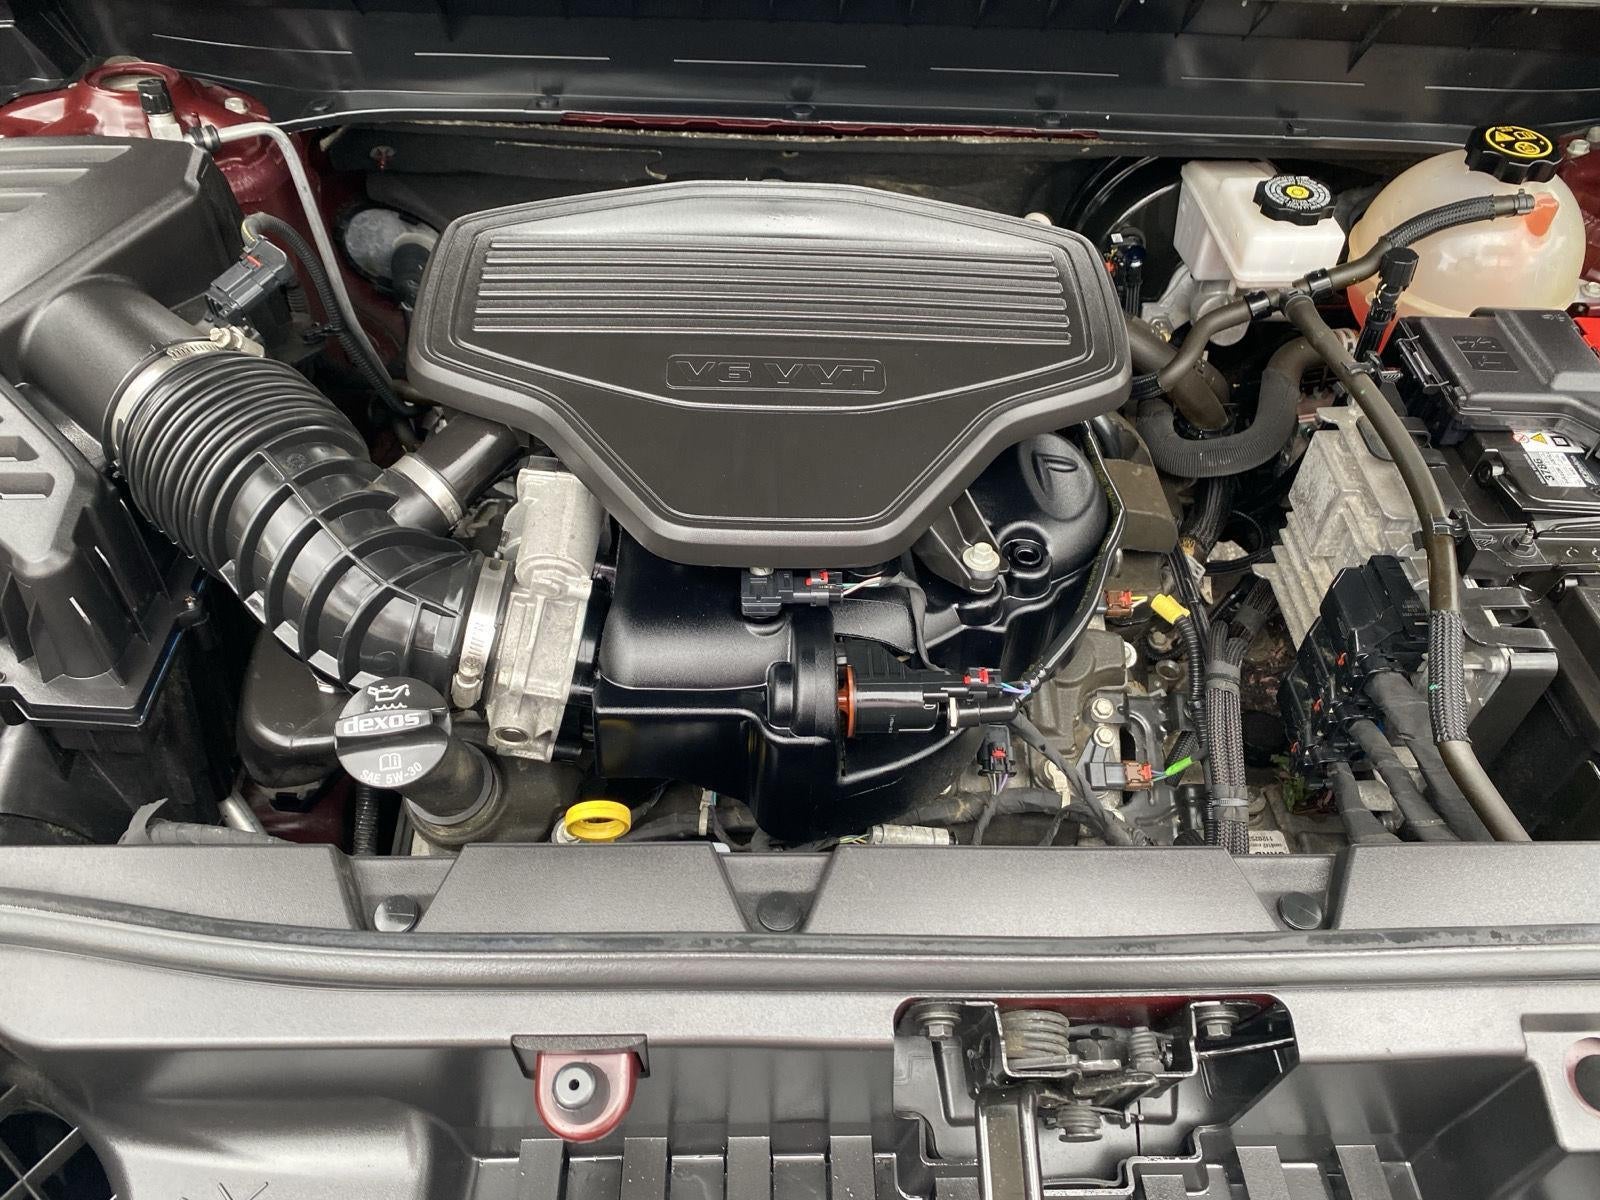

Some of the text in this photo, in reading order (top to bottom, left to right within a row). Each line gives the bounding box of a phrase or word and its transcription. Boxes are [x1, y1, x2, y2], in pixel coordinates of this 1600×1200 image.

[676, 361, 876, 385] V6 VVT
[343, 711, 422, 734] dexos
[360, 761, 423, 785] SAE 5W-30
